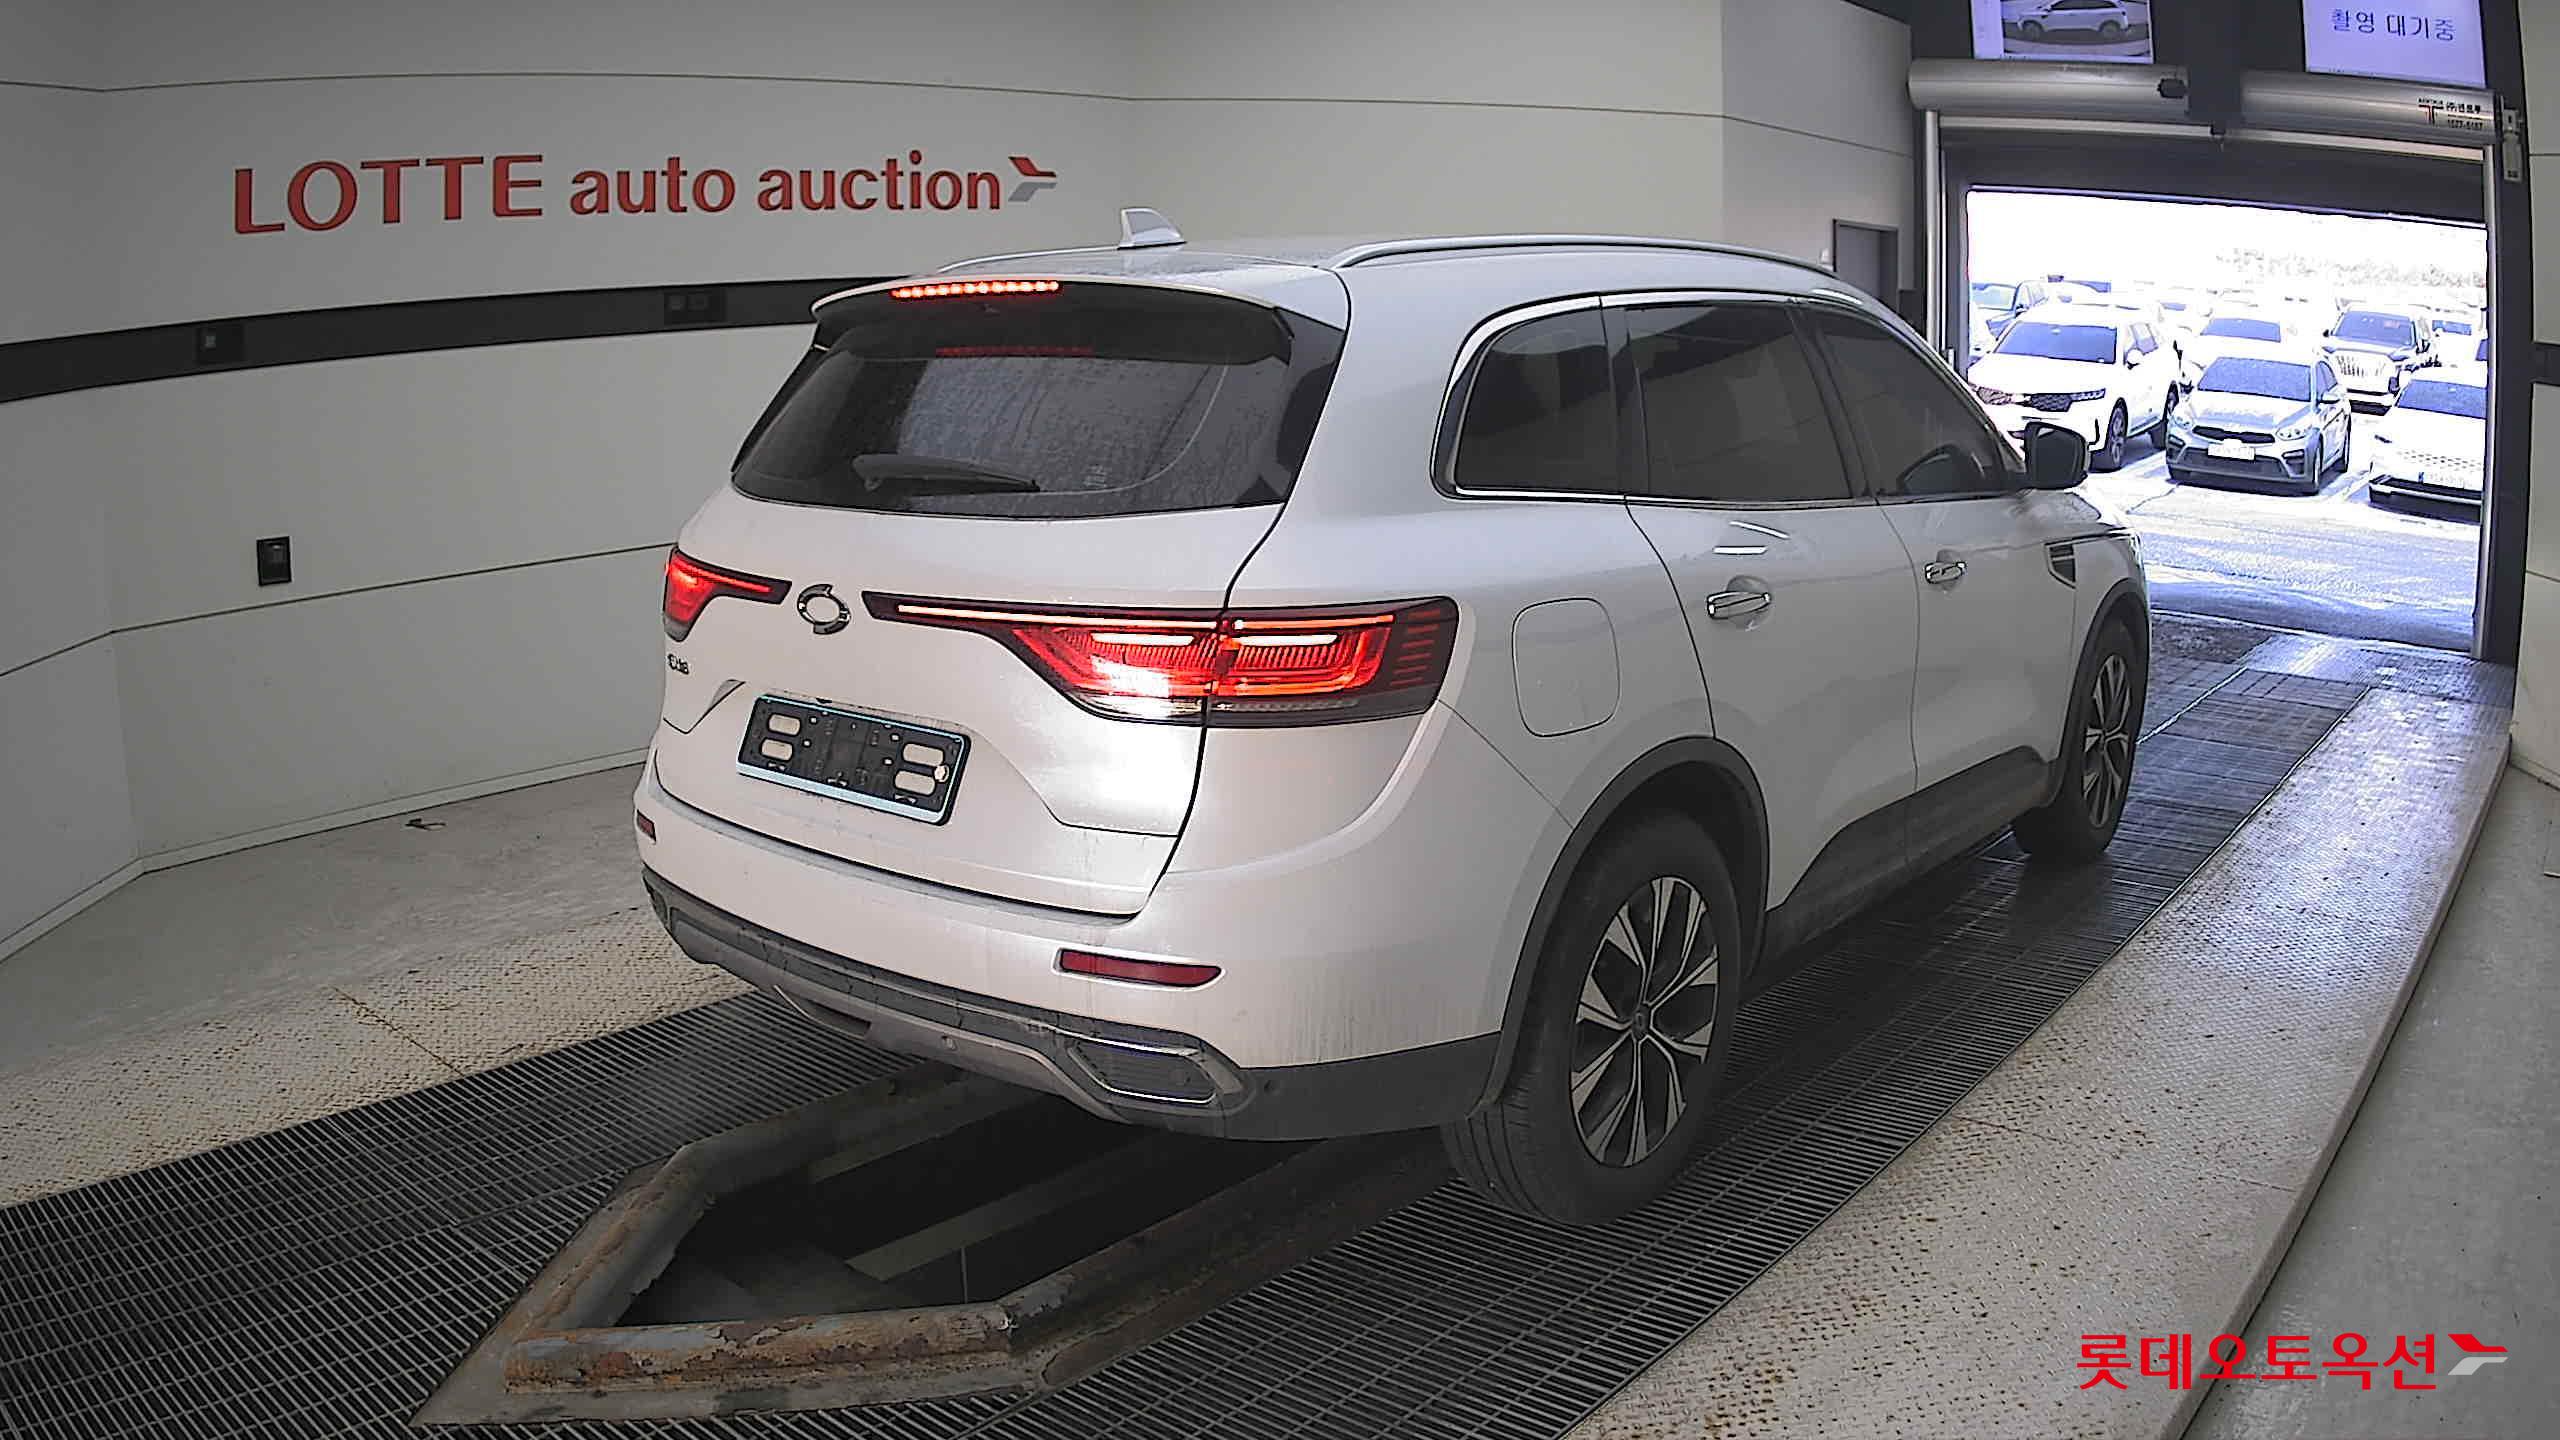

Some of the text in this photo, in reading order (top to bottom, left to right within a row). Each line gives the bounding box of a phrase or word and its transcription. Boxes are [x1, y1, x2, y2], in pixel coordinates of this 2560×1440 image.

[2386, 14, 2455, 42] 대기중
[234, 150, 1002, 235] LOTTE auto auction
